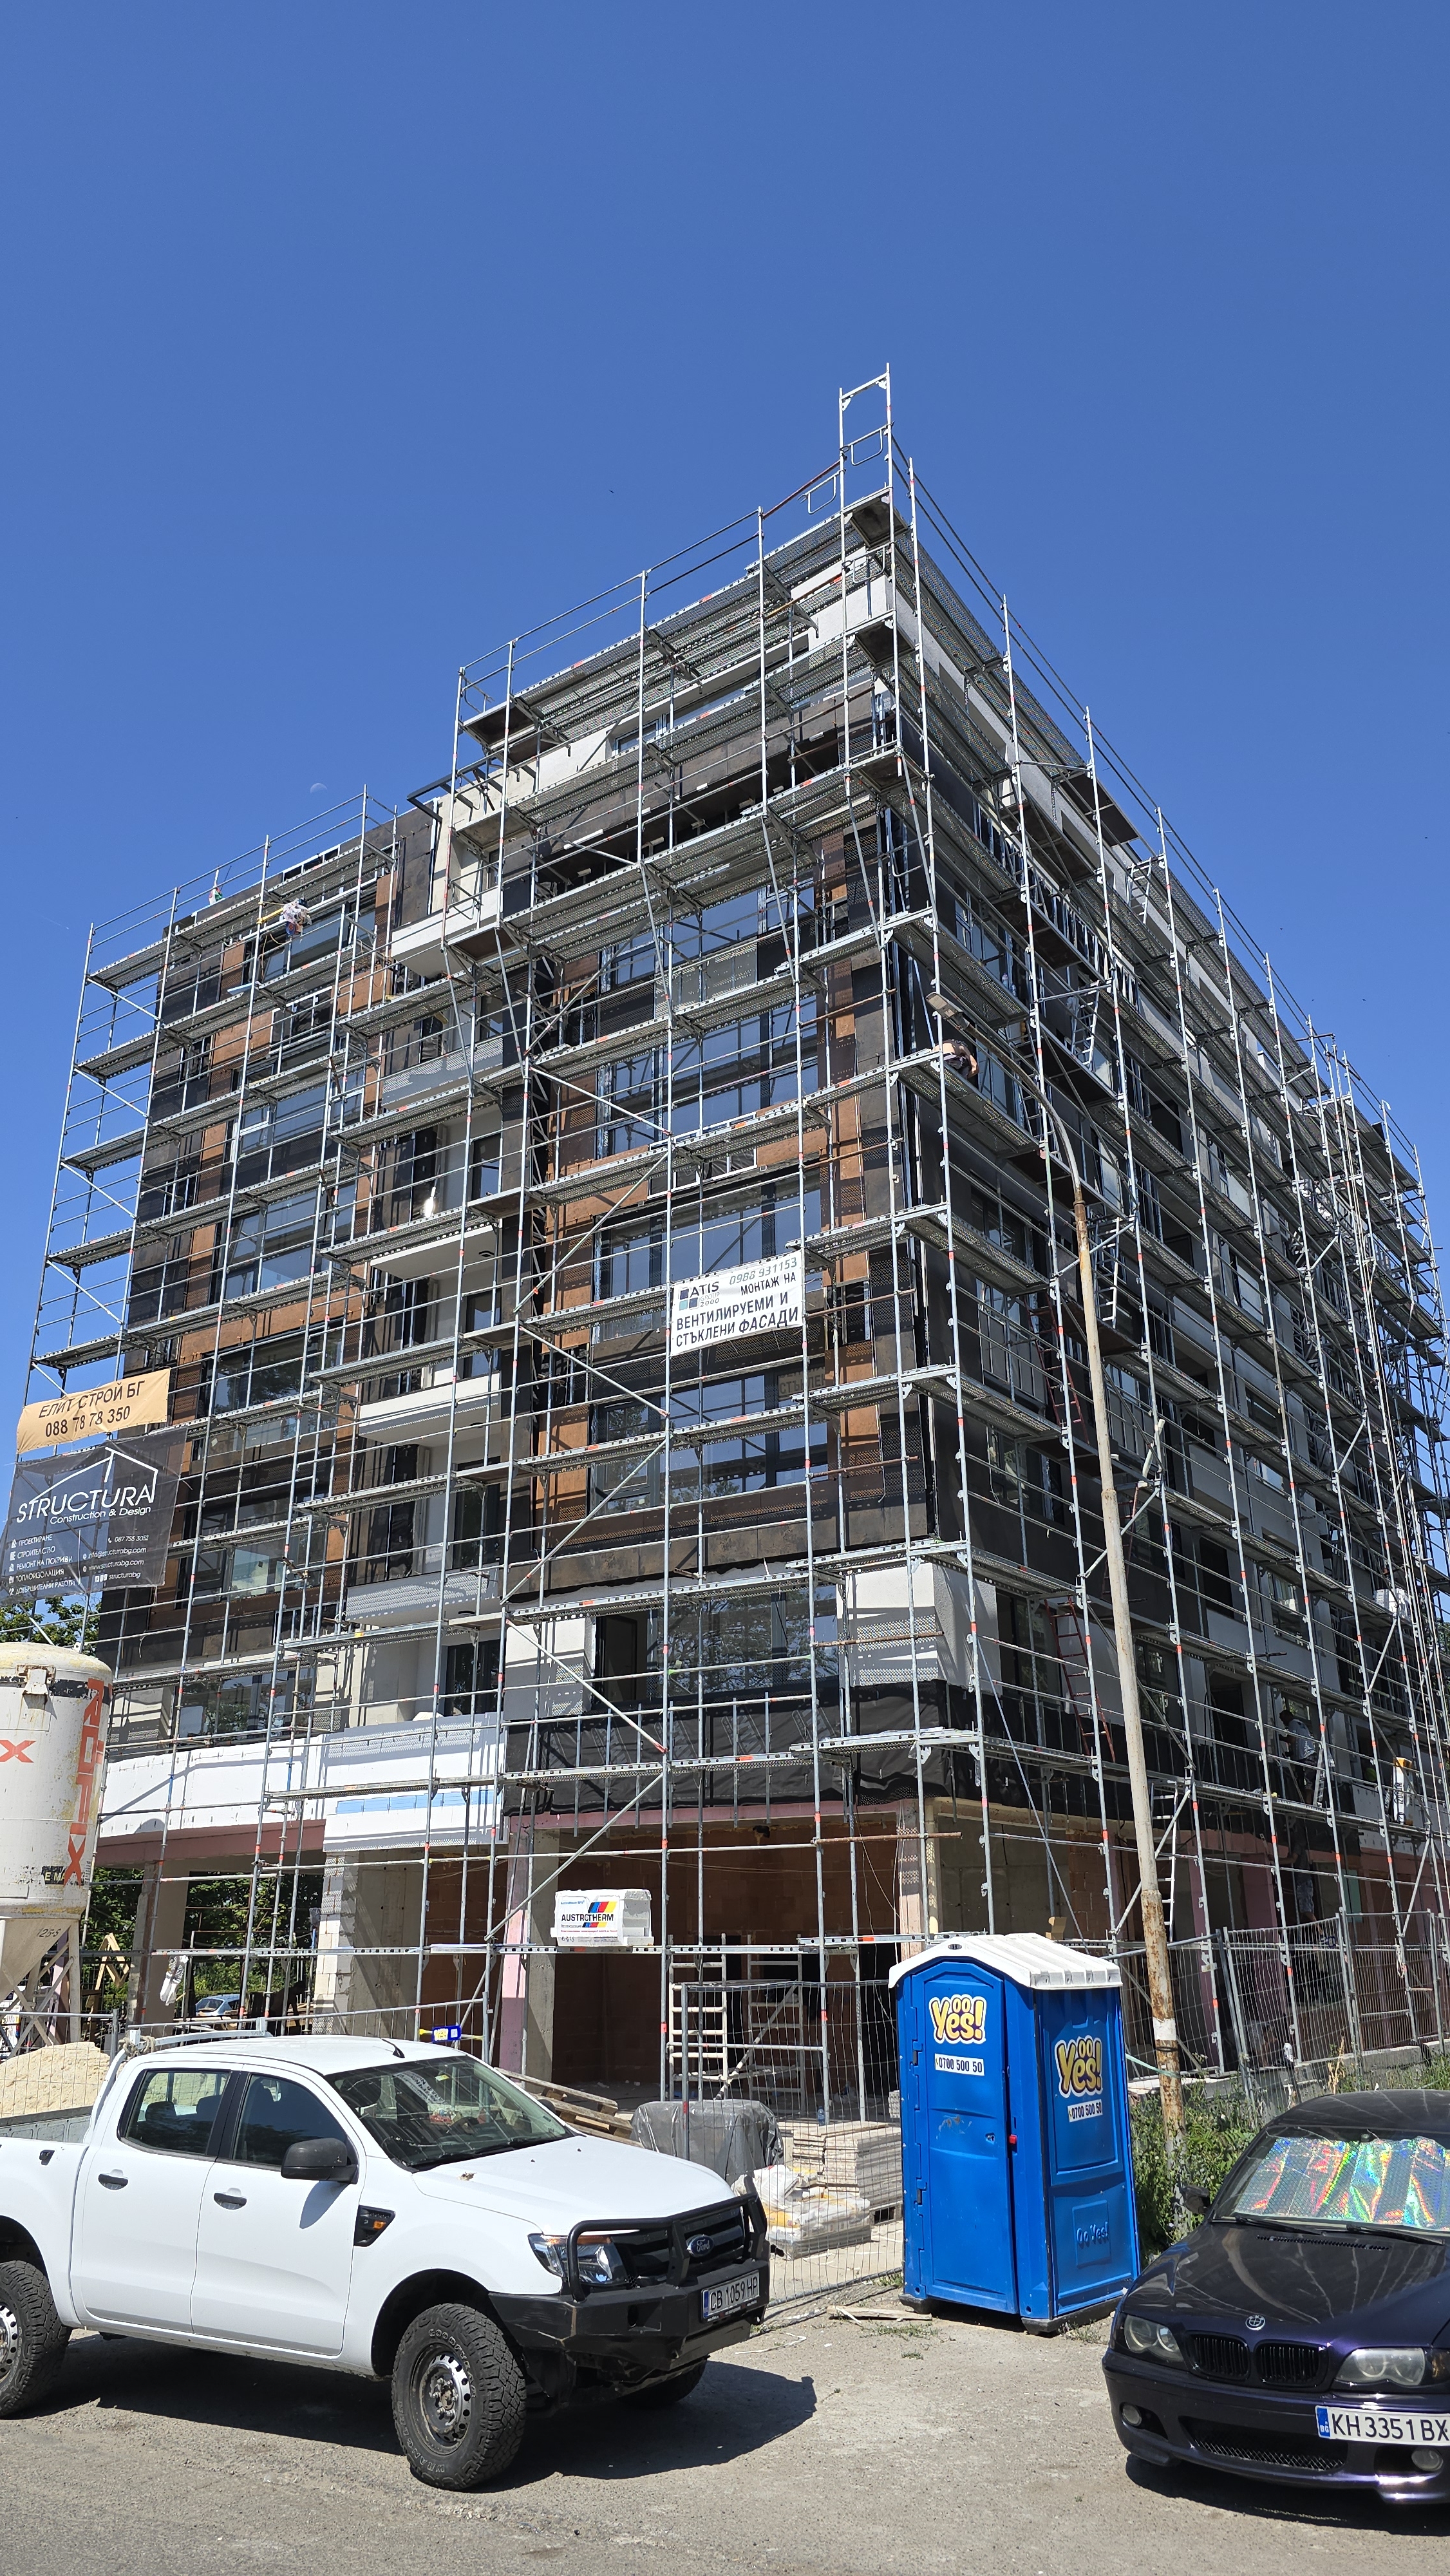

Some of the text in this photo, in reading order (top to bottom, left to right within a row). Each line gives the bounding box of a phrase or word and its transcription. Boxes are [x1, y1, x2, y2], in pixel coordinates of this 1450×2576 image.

[729, 1257, 797, 1285] 0988 931153
[690, 1282, 719, 1298] ATIS
[740, 1272, 796, 1296] МОНТАЖ НА
[701, 1292, 720, 1301] GROUP
[701, 1298, 719, 1307] 2000
[677, 1292, 787, 1331] ВЕНТИЛИРУЕМИ И
[676, 1307, 798, 1347] СТЪКЛЕНИ ФАСАДИ
[39, 1380, 145, 1418] ЕЛИТ СТРОЙ БГ
[46, 1405, 131, 1437] 088 78 78 350
[16, 1484, 154, 1523] STRUCTURA
[50, 1506, 151, 1524] Construction & Design
[16, 1560, 37, 1570] РЕМОНТ
[16, 1568, 64, 1582] ТОПЛОИЗОЛАЦИЯ
[561, 1913, 614, 1922] AUSTROTHERM
[930, 1999, 984, 2041] Yes!
[939, 2057, 983, 2073] 0700 500 50
[1057, 2040, 1102, 2095] Yes!
[1071, 2101, 1102, 2119] 0700 500 50
[697, 2239, 710, 2252] Ford
[710, 2290, 722, 2311] CB
[726, 2281, 746, 2305] 1059
[747, 2277, 758, 2297] HP
[1332, 2413, 1450, 2441] KH 3351 BX
